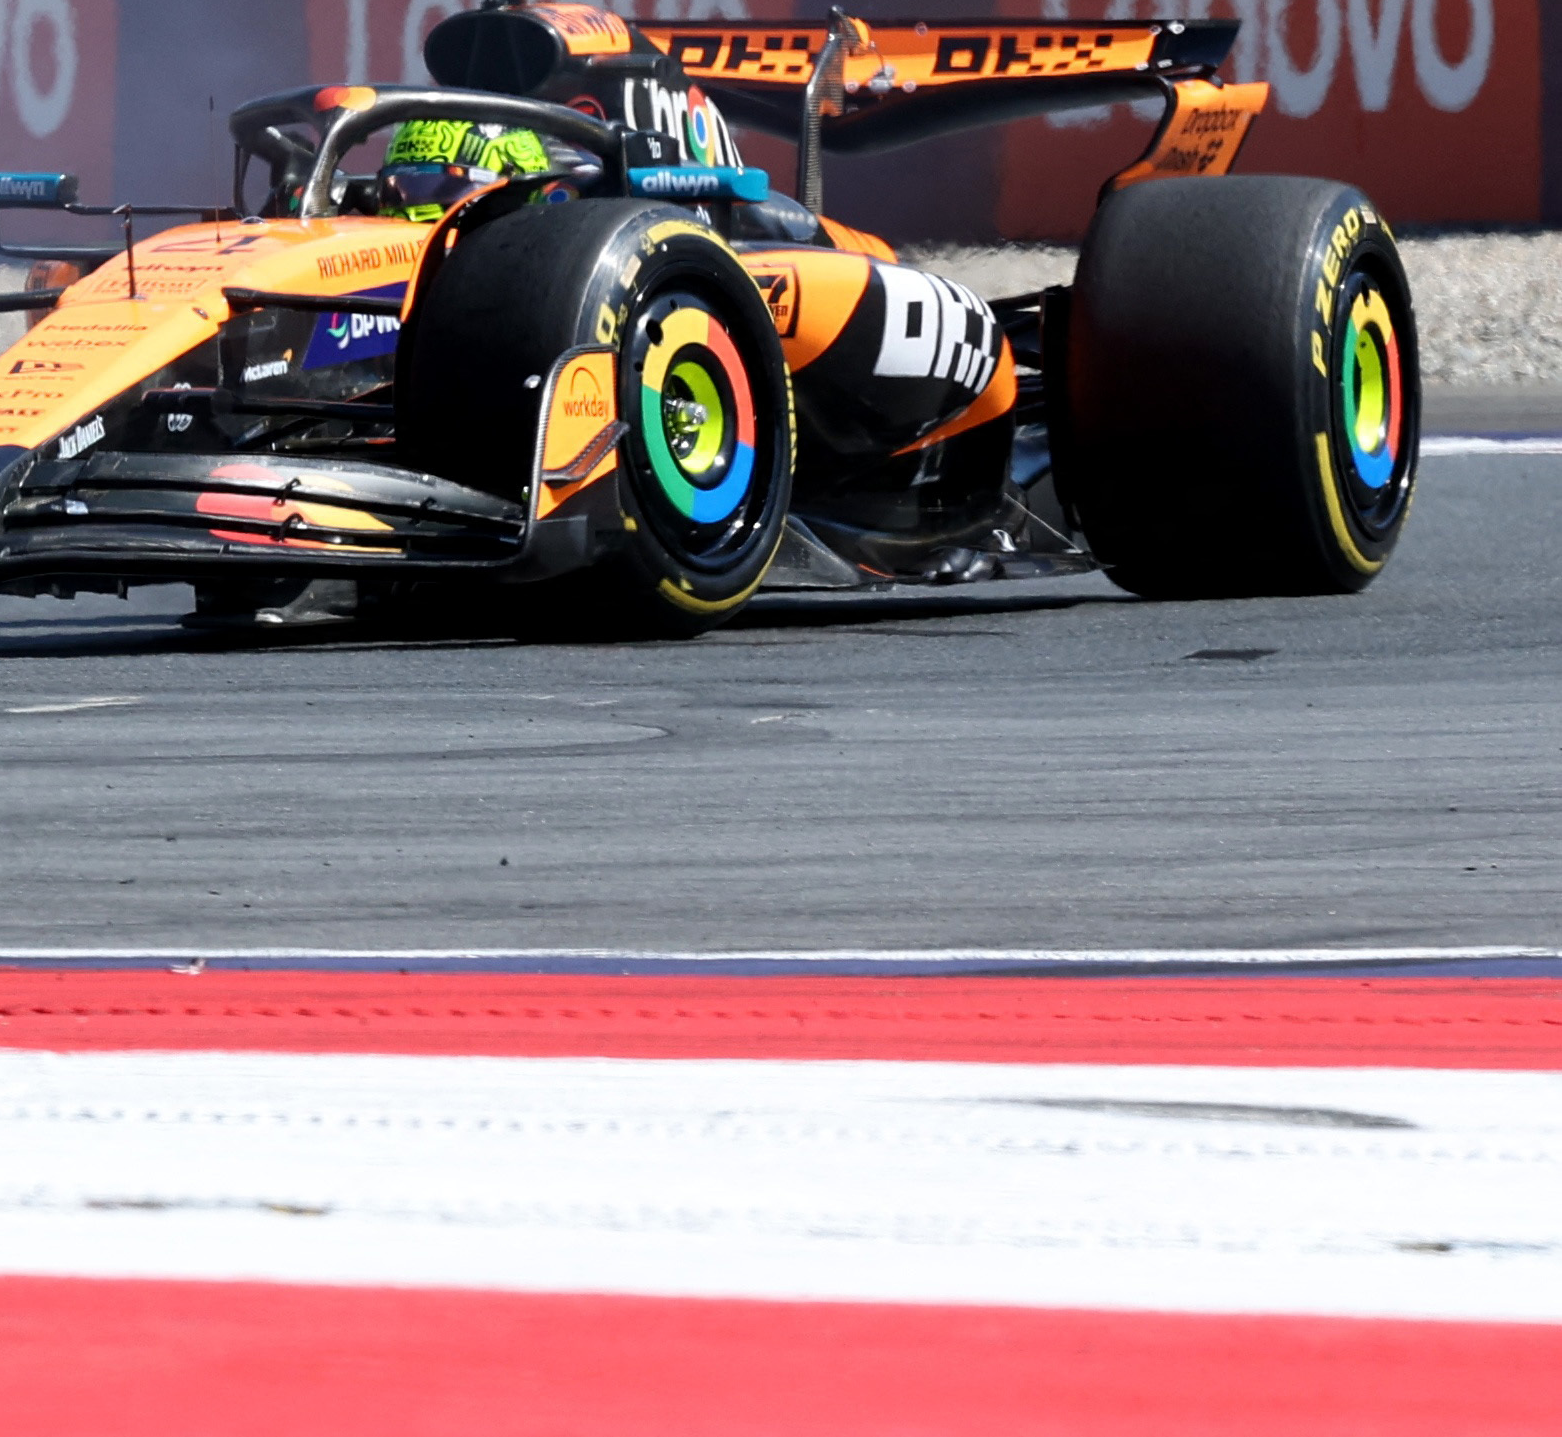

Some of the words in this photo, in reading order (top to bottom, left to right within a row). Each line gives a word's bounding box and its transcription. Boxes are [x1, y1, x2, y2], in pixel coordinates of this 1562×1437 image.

[641, 171, 720, 196] allwyn
[317, 247, 381, 280] RICHARD
[562, 395, 610, 422] workday
